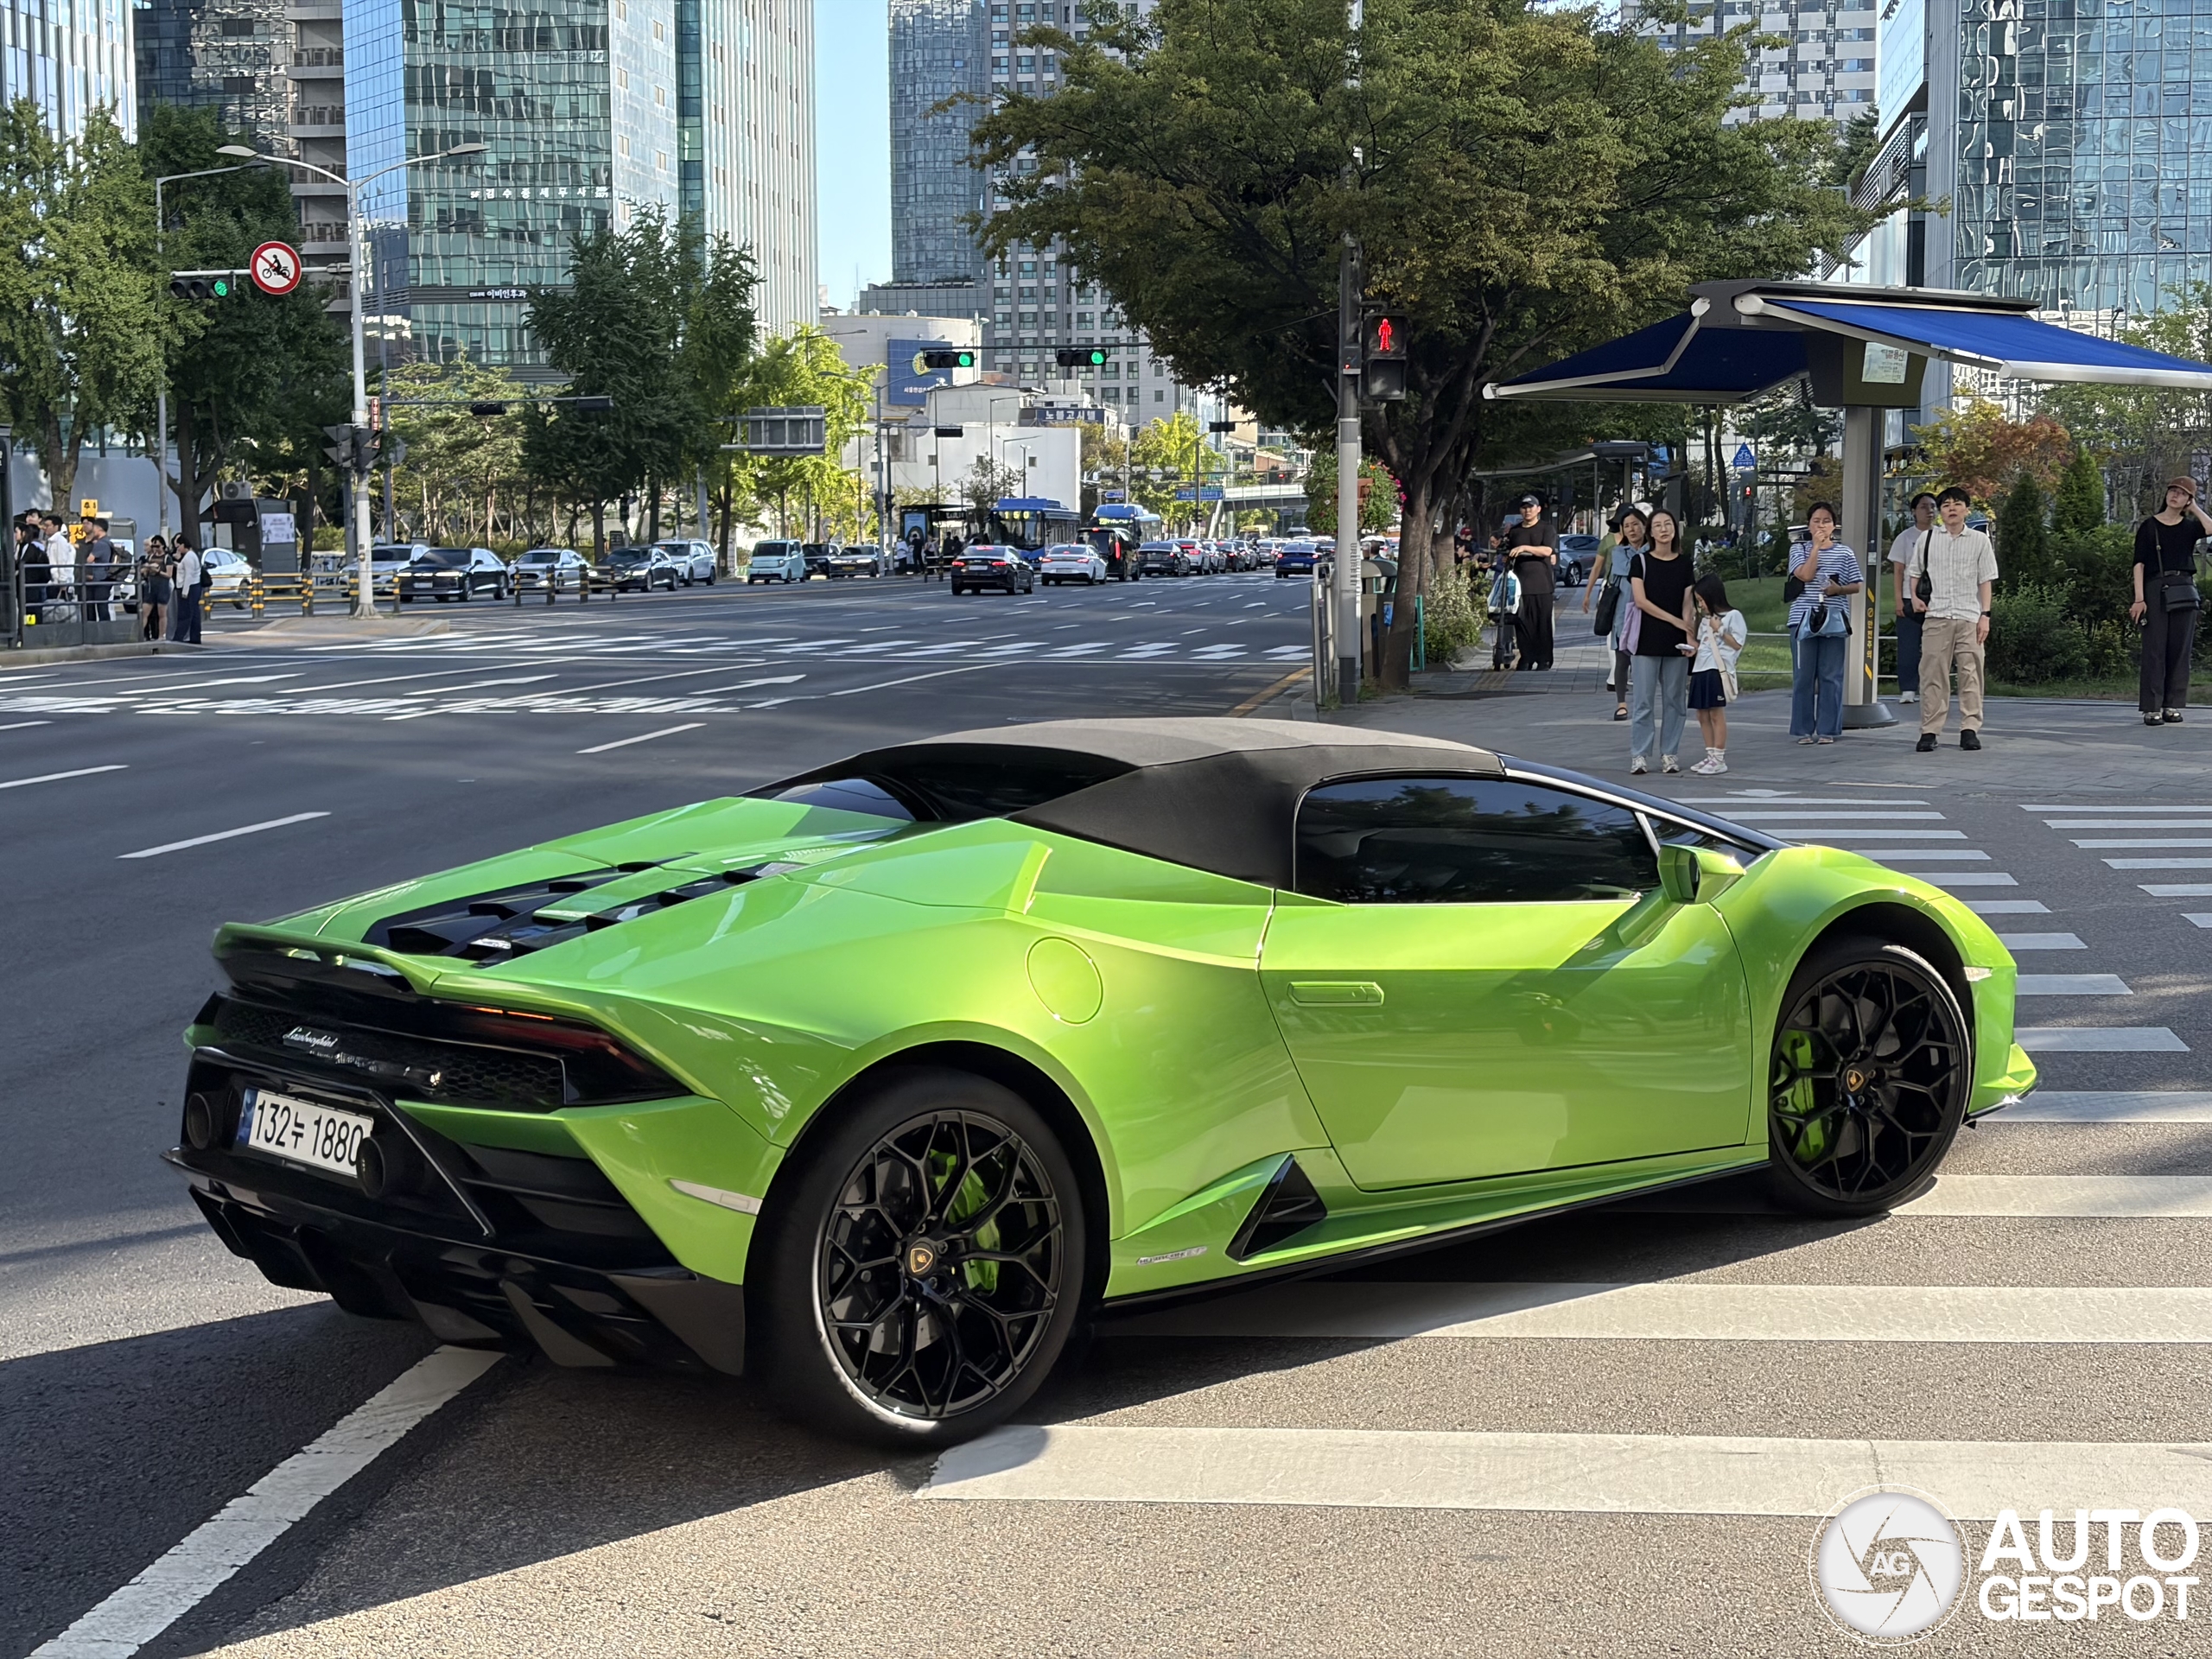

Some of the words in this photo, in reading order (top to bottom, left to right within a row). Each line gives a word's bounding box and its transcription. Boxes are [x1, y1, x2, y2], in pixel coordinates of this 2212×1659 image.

[1005, 511, 1029, 519] 150
[283, 1027, 338, 1048] Lamborghini
[257, 1100, 304, 1149] 132누
[313, 1115, 364, 1166] 1880
